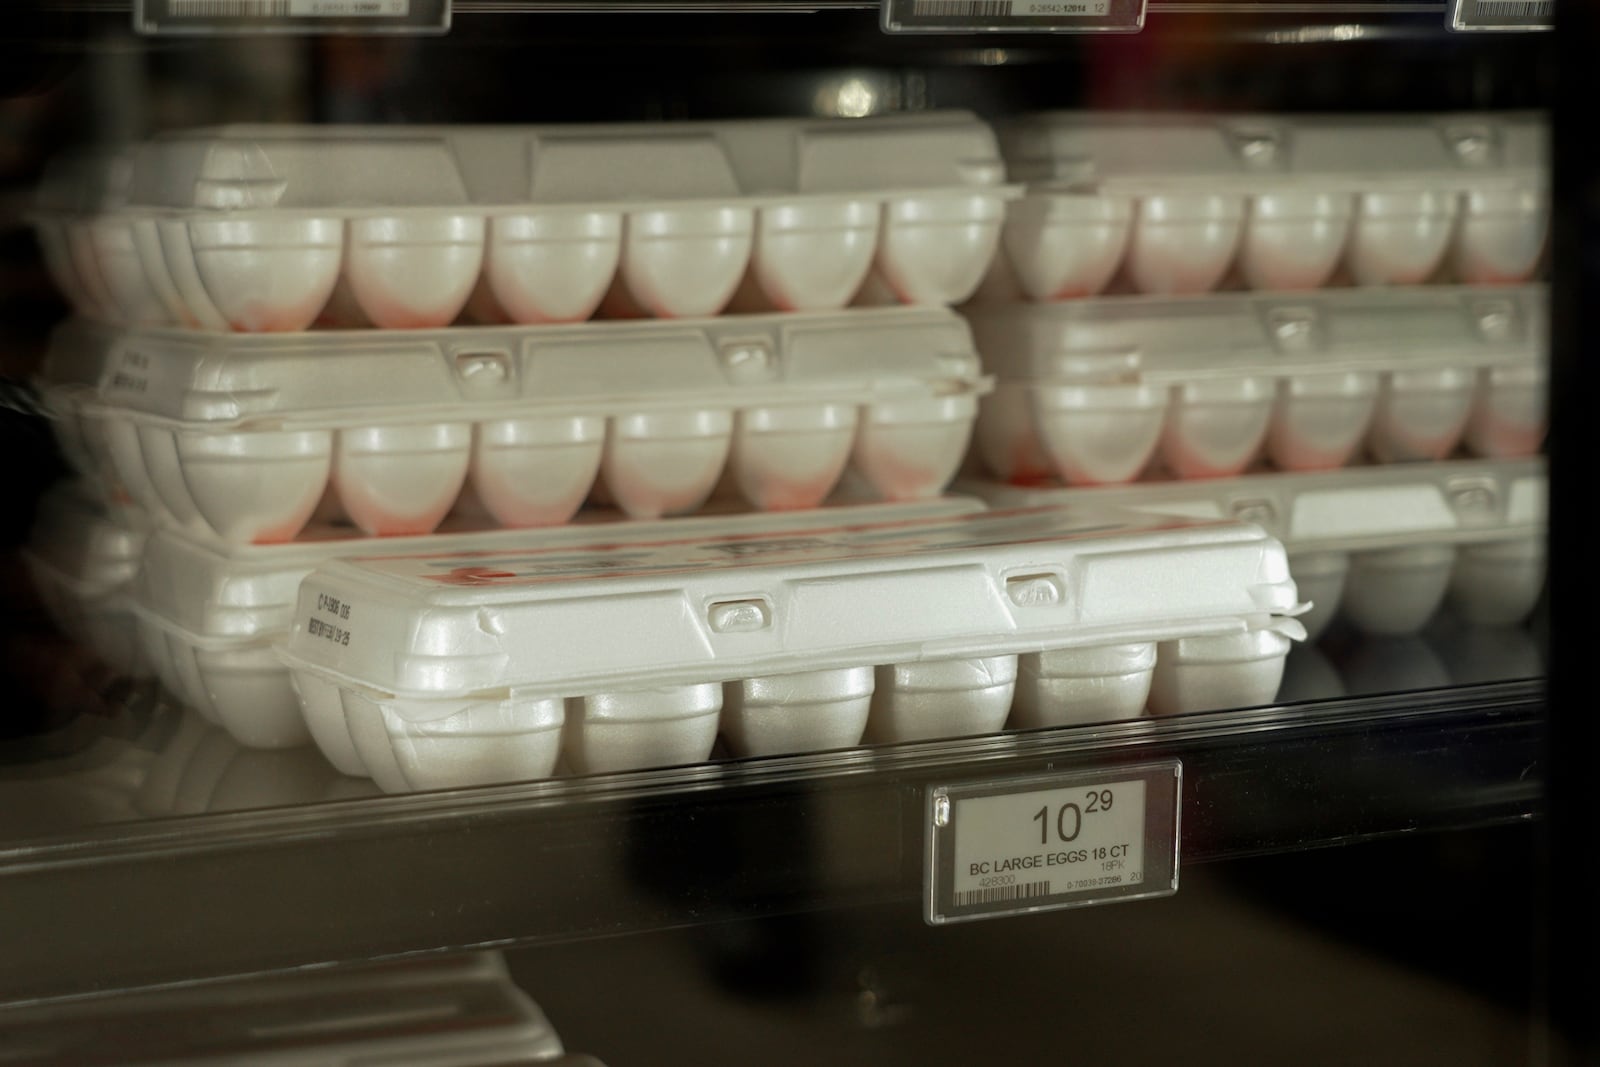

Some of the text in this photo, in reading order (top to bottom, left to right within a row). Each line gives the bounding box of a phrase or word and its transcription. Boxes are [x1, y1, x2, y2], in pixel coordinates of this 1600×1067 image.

[1095, 3, 1105, 13] 12
[1033, 789, 1113, 845] 10 29
[970, 844, 1129, 876] BC LARGE EGGS 18 CT
[1101, 859, 1126, 872] 18PK
[979, 874, 1016, 888] 428300
